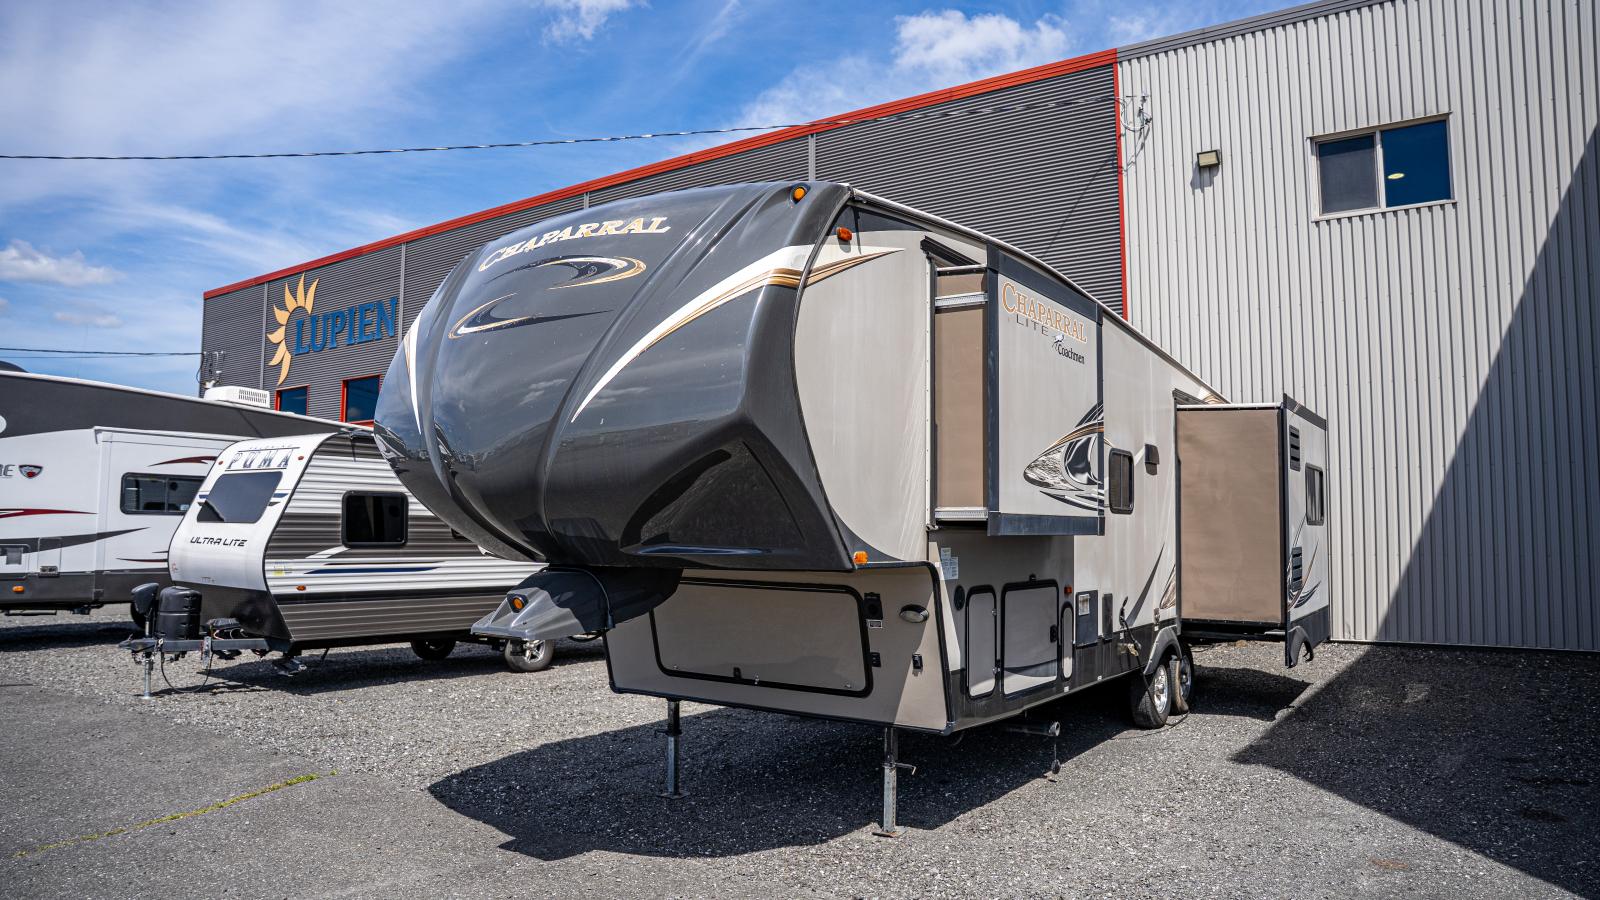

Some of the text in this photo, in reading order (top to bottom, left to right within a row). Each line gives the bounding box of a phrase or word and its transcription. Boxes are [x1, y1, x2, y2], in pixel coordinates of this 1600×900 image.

[478, 216, 671, 272] CHAPARRAL
[1002, 282, 1087, 343] CHAPARRAL
[294, 296, 398, 356] LUPIEN
[1016, 313, 1049, 336] LITE
[1057, 343, 1085, 365] Coachmen
[226, 449, 294, 469] PUMA
[190, 536, 248, 547] ULTRA LITE
